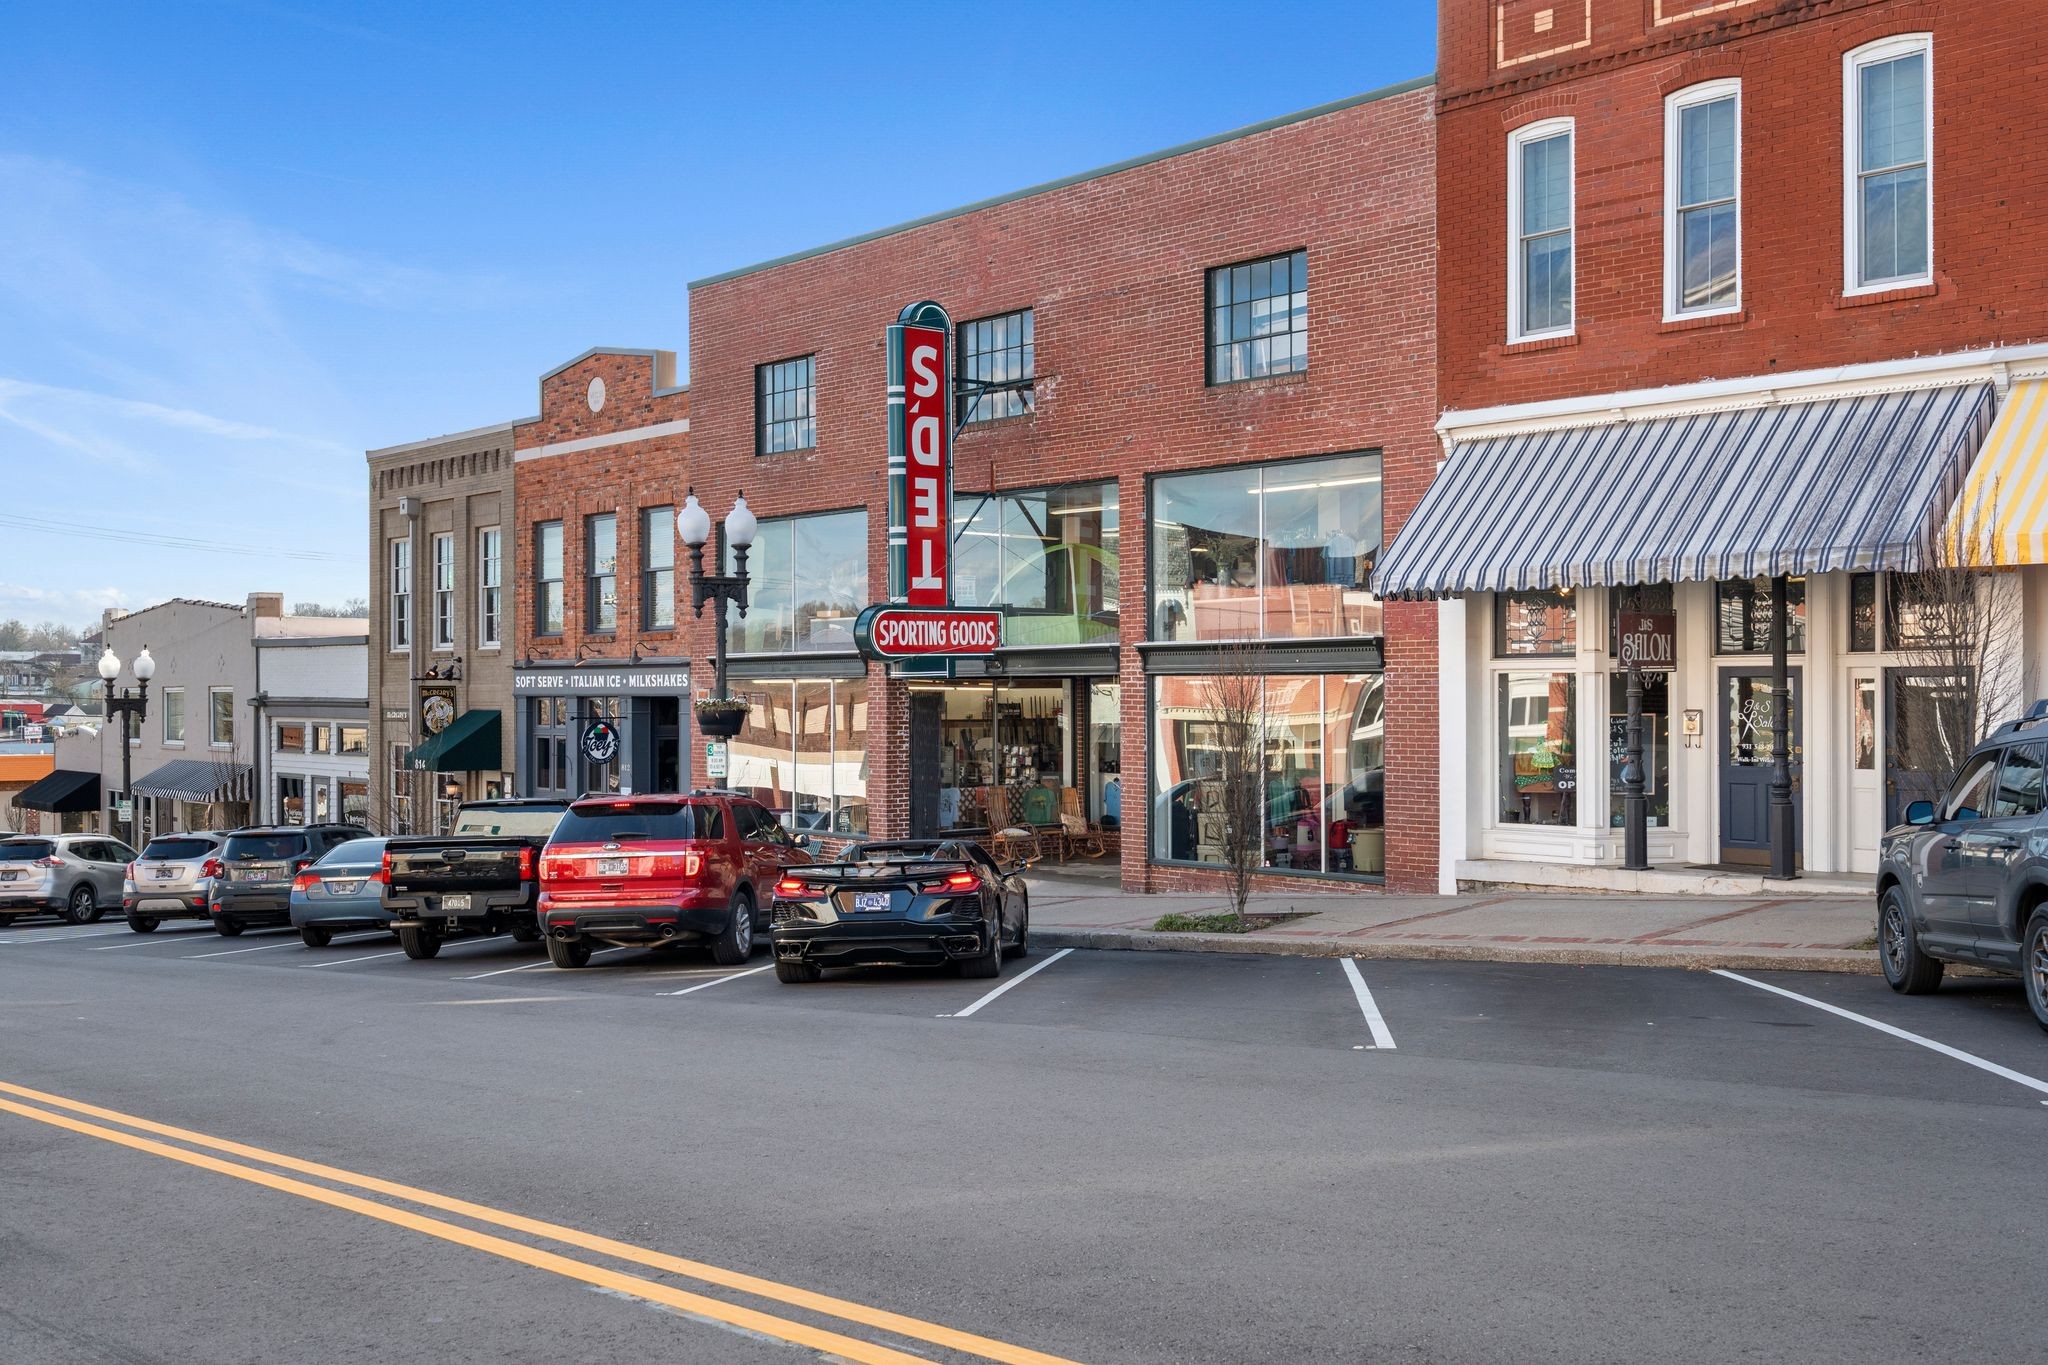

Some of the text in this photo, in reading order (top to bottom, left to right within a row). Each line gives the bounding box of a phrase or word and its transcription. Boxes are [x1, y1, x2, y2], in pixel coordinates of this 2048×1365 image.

[908, 345, 943, 590] TED'S
[879, 619, 997, 647] SPORTING GOODS
[1621, 632, 1672, 666] SALON
[515, 673, 689, 688] SOFT SERVE ITALIAN ICE MILKSHAKES
[1558, 780, 1576, 789] OP
[855, 897, 890, 908] BJZ 4340
